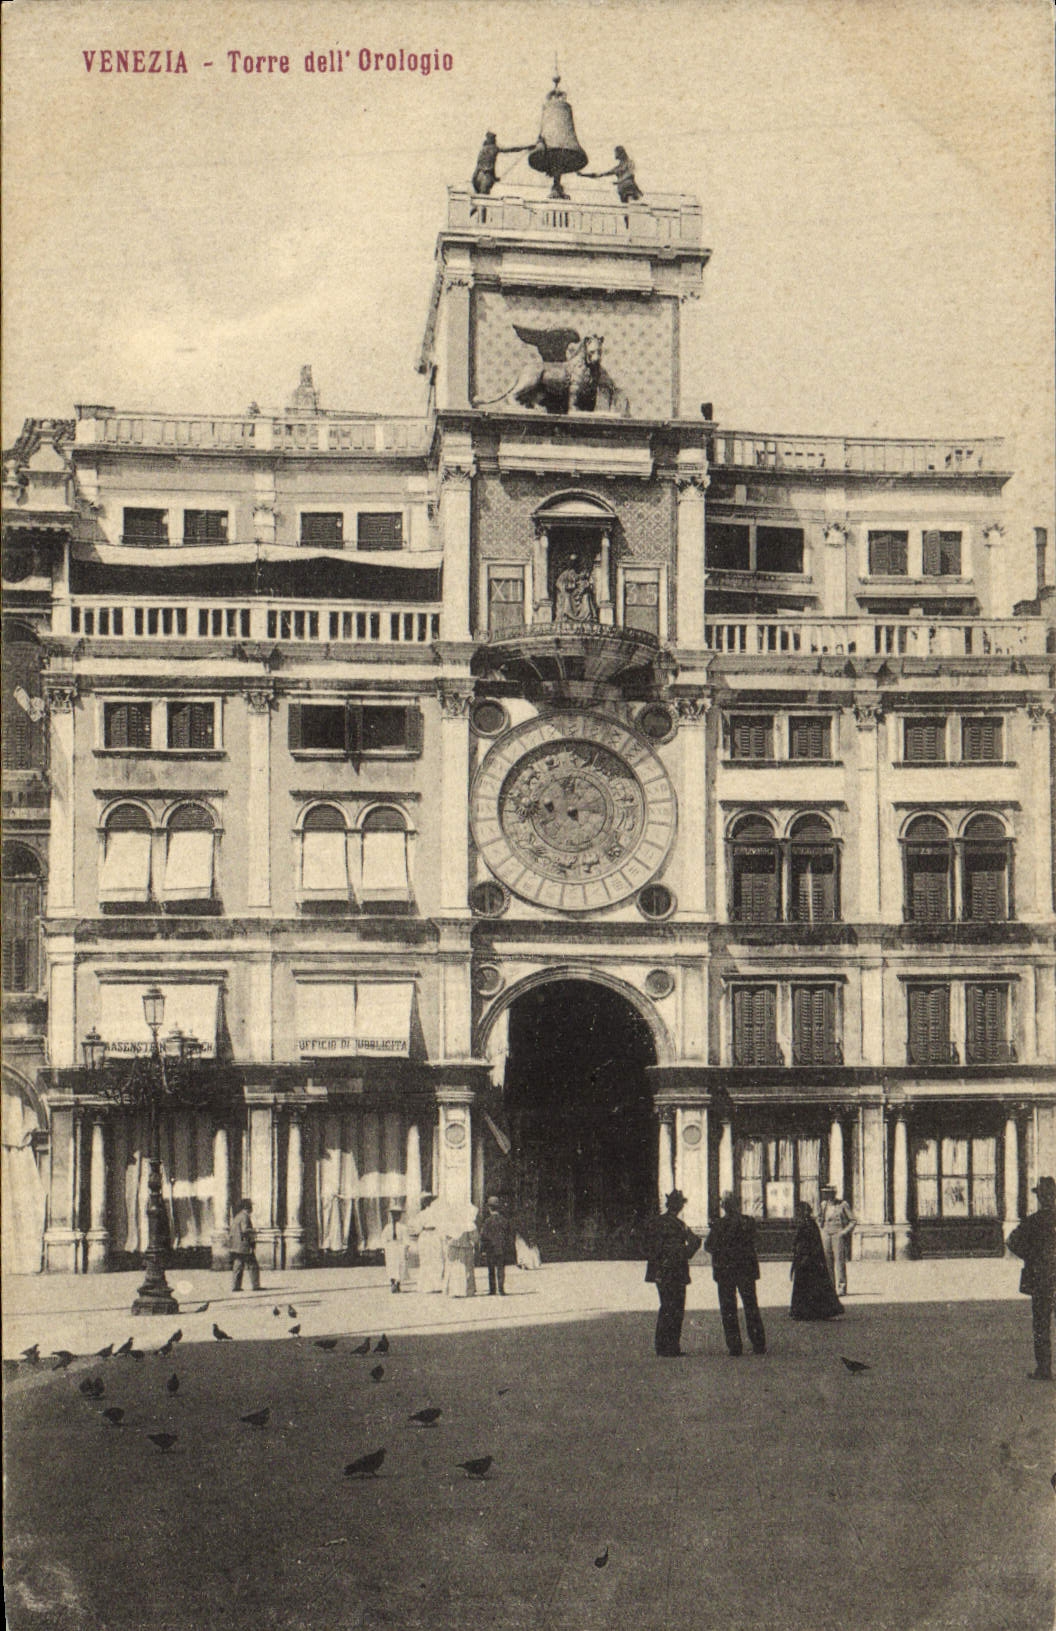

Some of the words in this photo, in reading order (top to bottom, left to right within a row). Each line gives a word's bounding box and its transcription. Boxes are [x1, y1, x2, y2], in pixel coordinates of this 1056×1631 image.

[491, 580, 522, 601] XII
[298, 1039, 336, 1050] UFFICIO
[341, 1039, 350, 1050] DI
